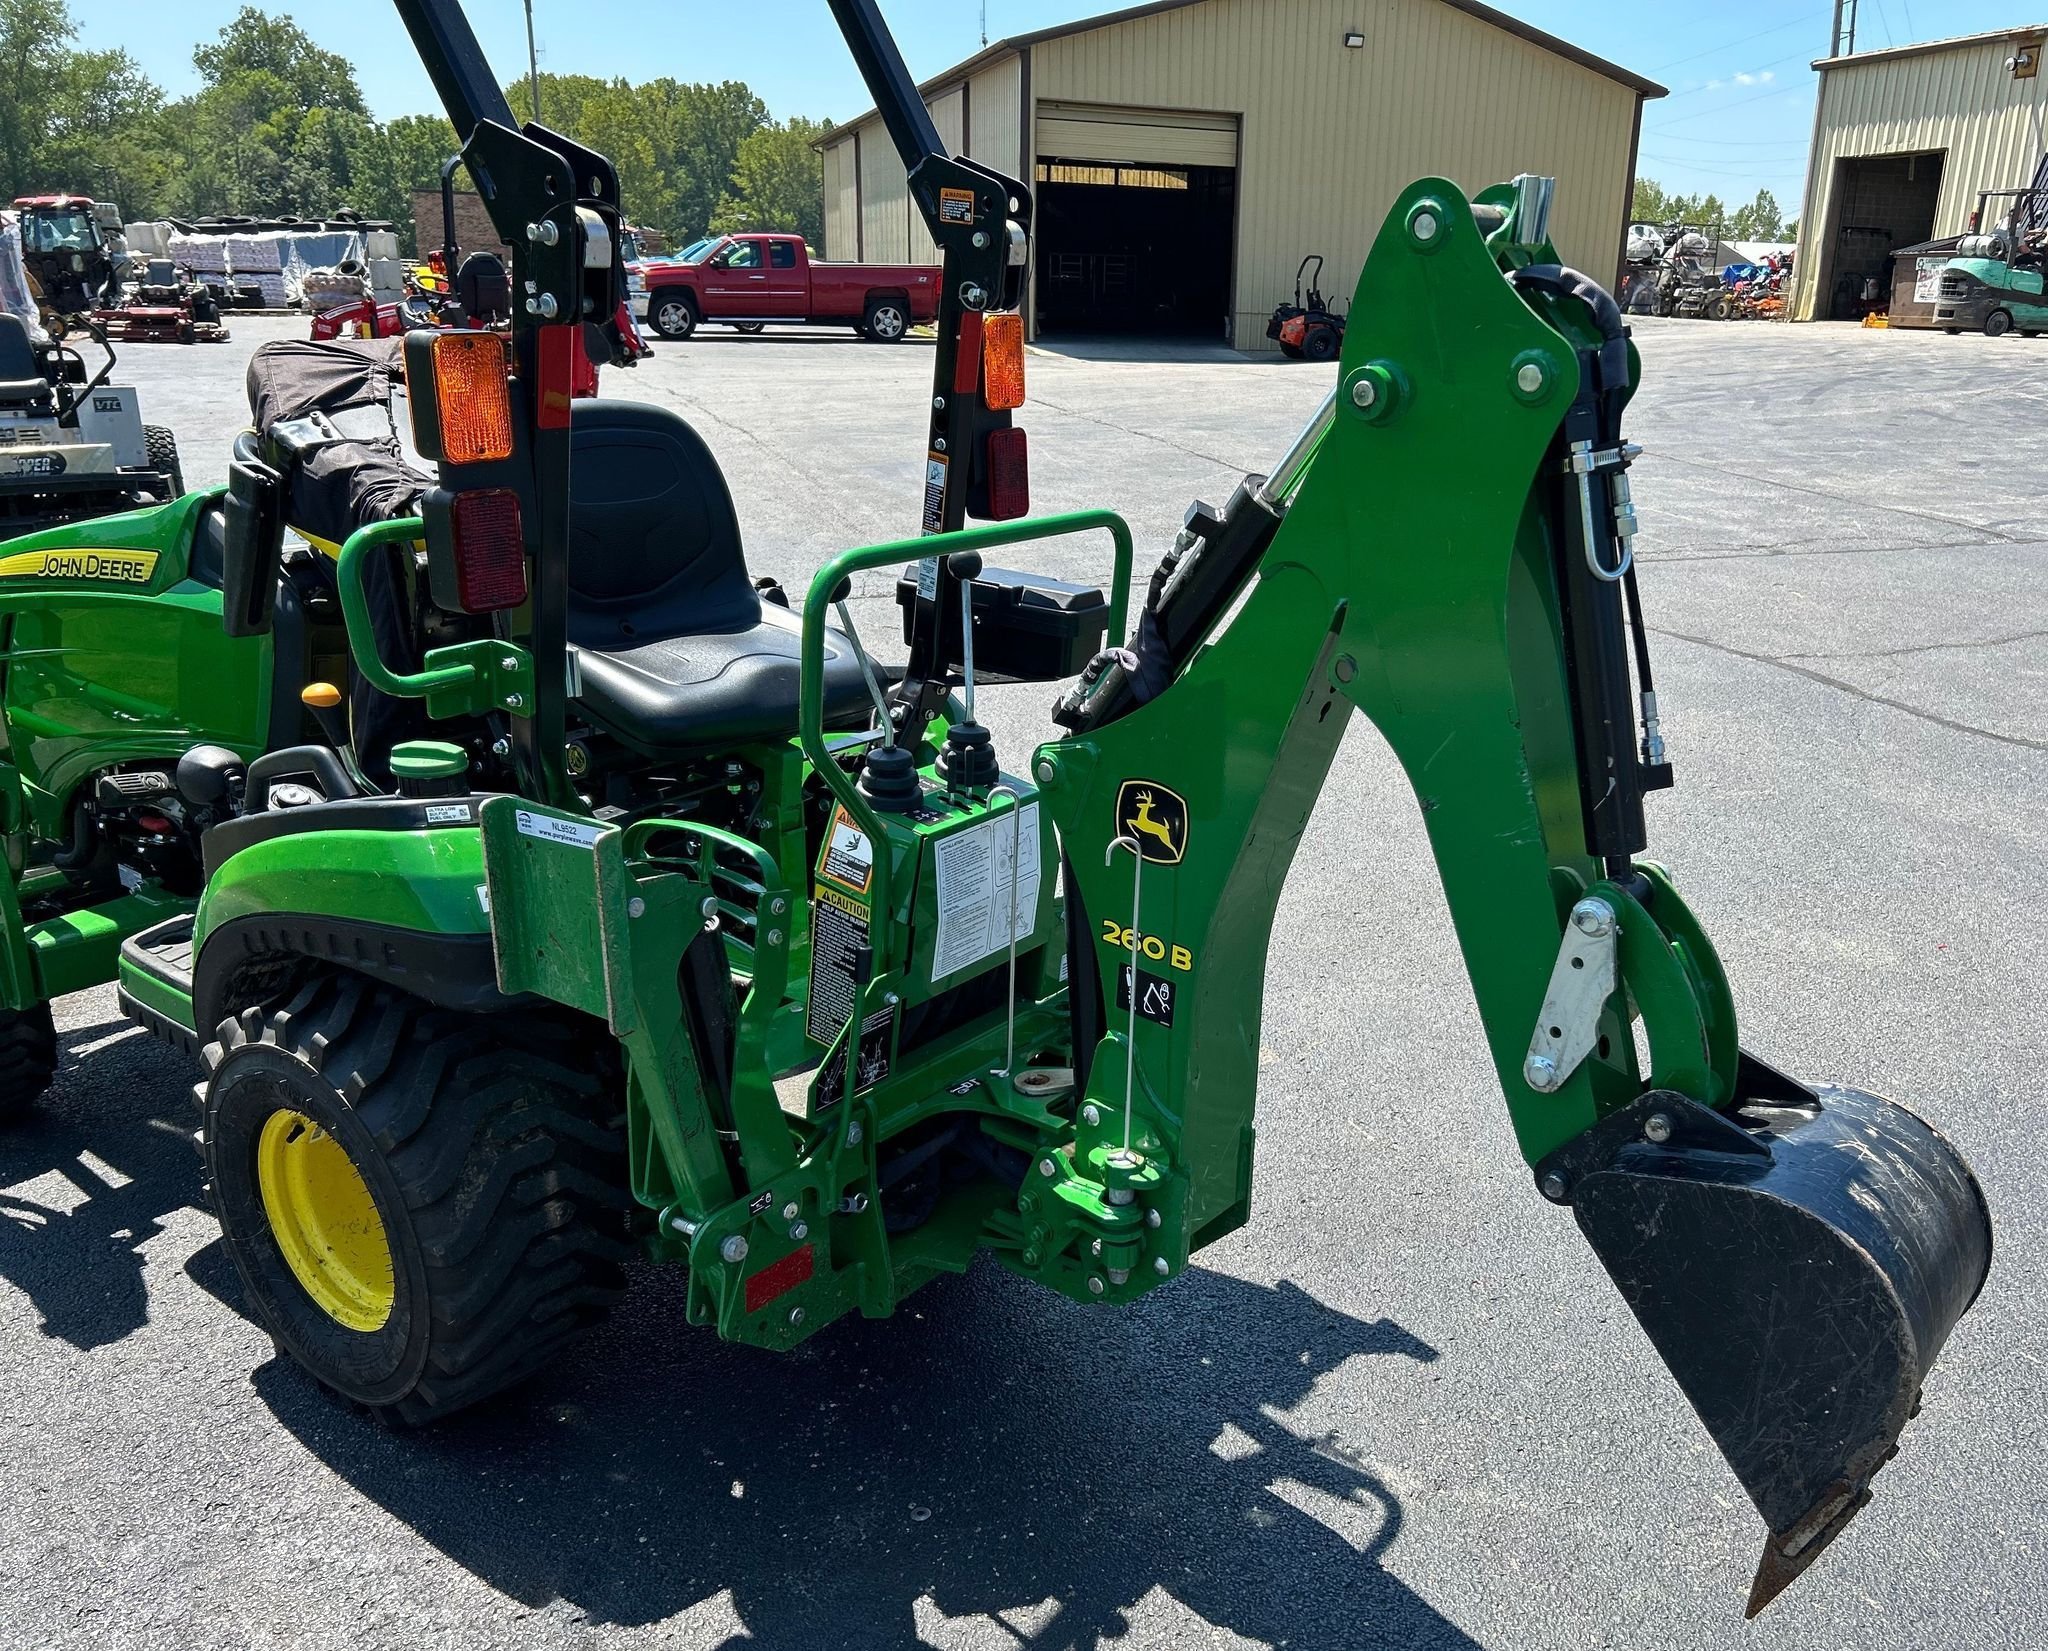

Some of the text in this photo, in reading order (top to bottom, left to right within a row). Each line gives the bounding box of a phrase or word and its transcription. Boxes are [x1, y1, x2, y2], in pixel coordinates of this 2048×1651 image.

[95, 400, 121, 410] VTC
[38, 554, 145, 579] JOHN DEERE
[538, 829, 594, 846] www.purplewave.com
[551, 821, 577, 836] NL9522
[821, 903, 868, 929] HELP AVOID INJURY
[831, 893, 869, 920] CAUTION
[1102, 920, 1193, 972] 260 B
